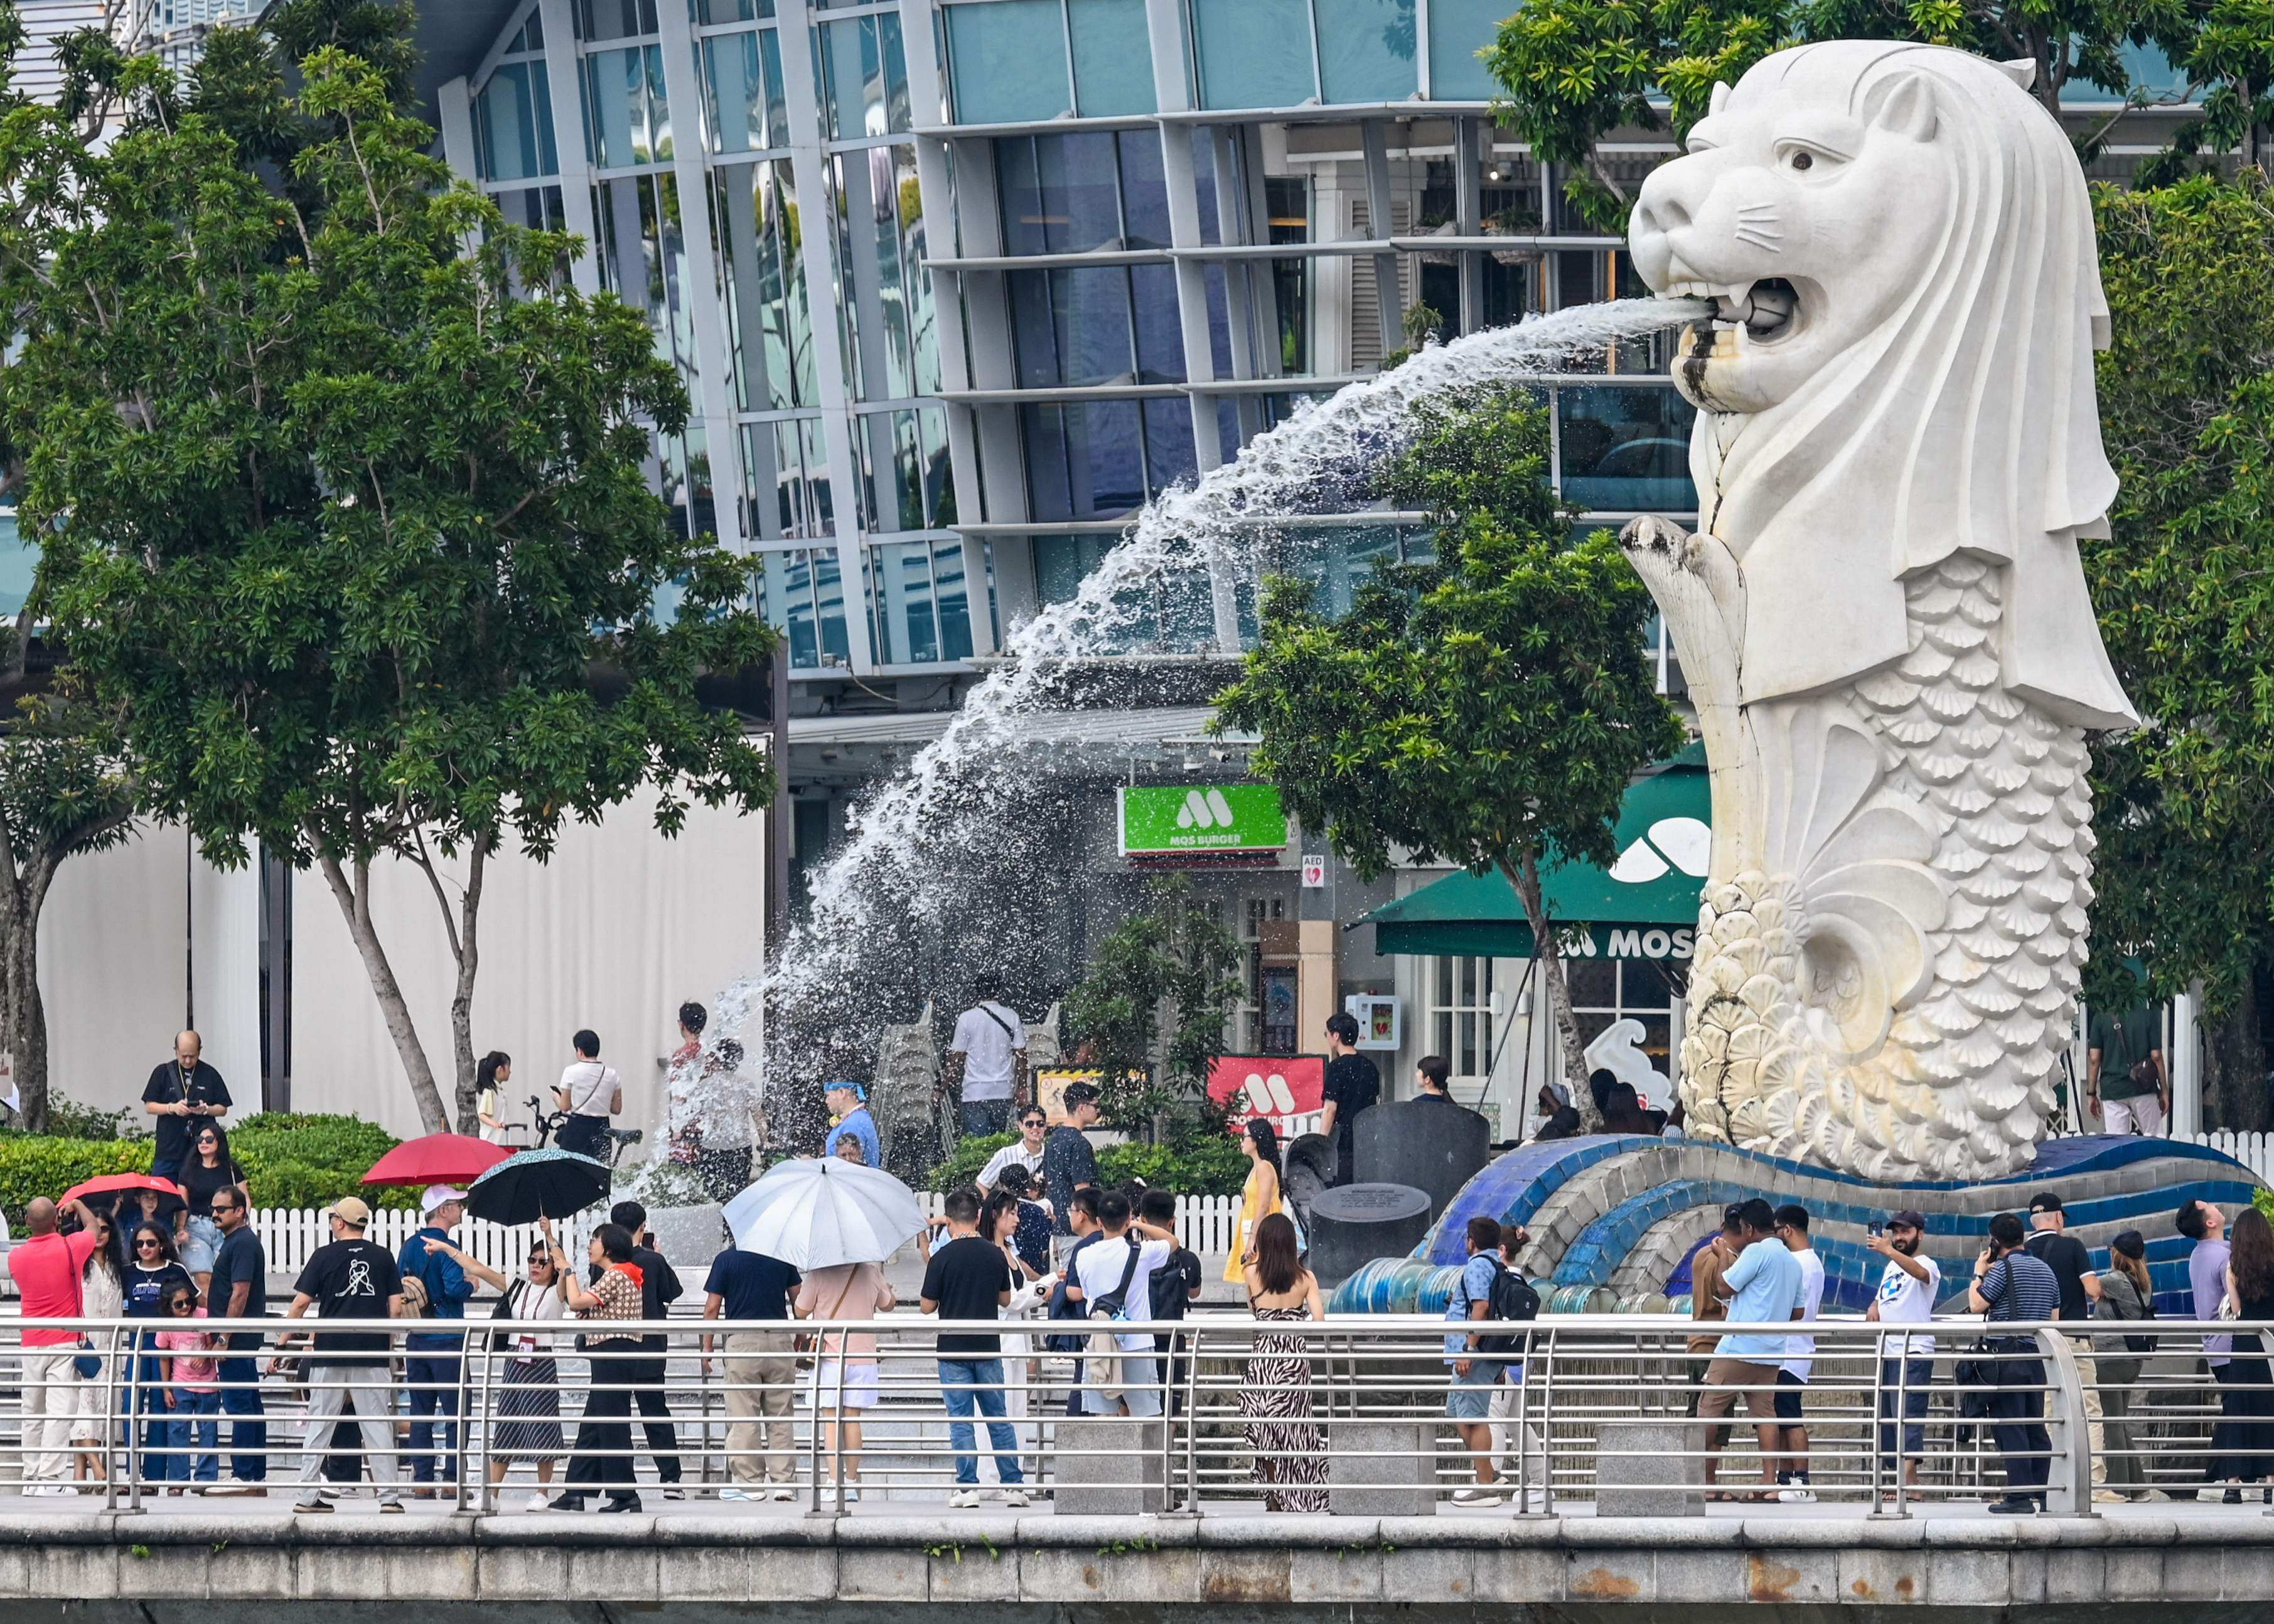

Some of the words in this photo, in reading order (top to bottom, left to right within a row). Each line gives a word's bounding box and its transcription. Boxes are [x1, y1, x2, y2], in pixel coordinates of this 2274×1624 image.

[1171, 835, 1195, 845] MOS
[1198, 834, 1241, 845] BURGER
[1607, 929, 1694, 959] MOS
